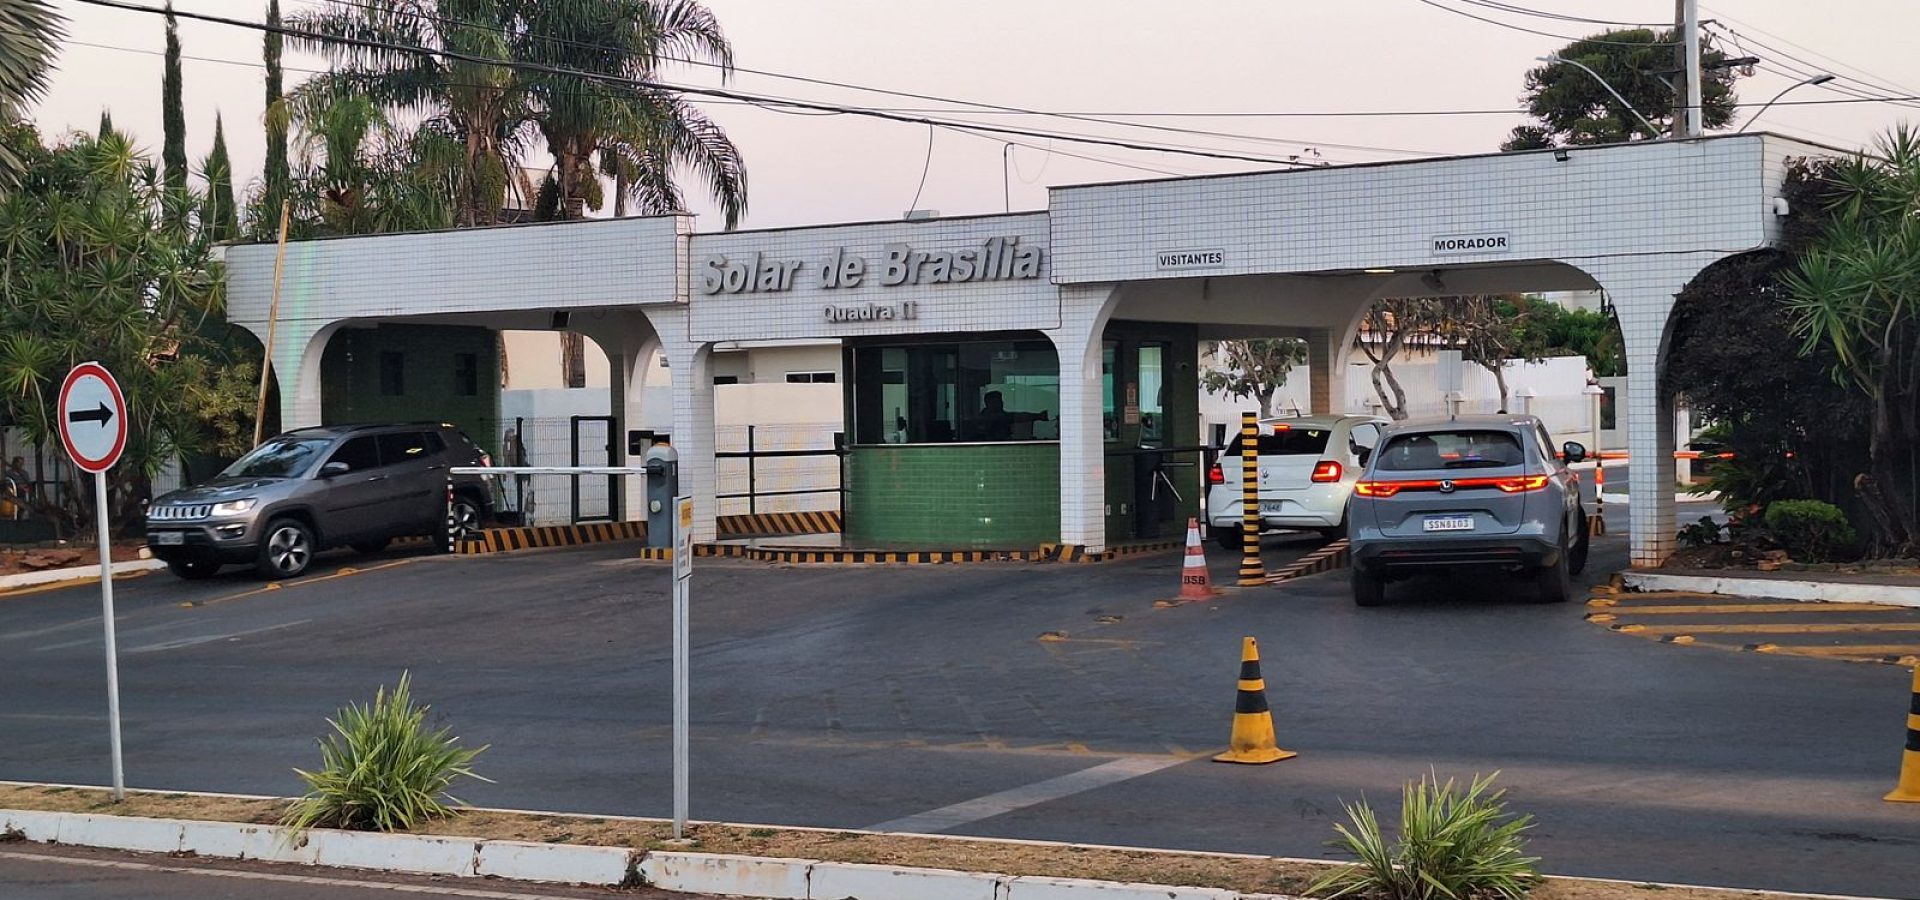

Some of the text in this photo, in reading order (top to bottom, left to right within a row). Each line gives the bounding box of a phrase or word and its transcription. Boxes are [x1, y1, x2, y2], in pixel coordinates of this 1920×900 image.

[1434, 237, 1506, 251] MORADOR
[702, 236, 1042, 296] Solar de Brasília
[1160, 252, 1222, 266] VISITANTES
[823, 303, 895, 323] Quadra
